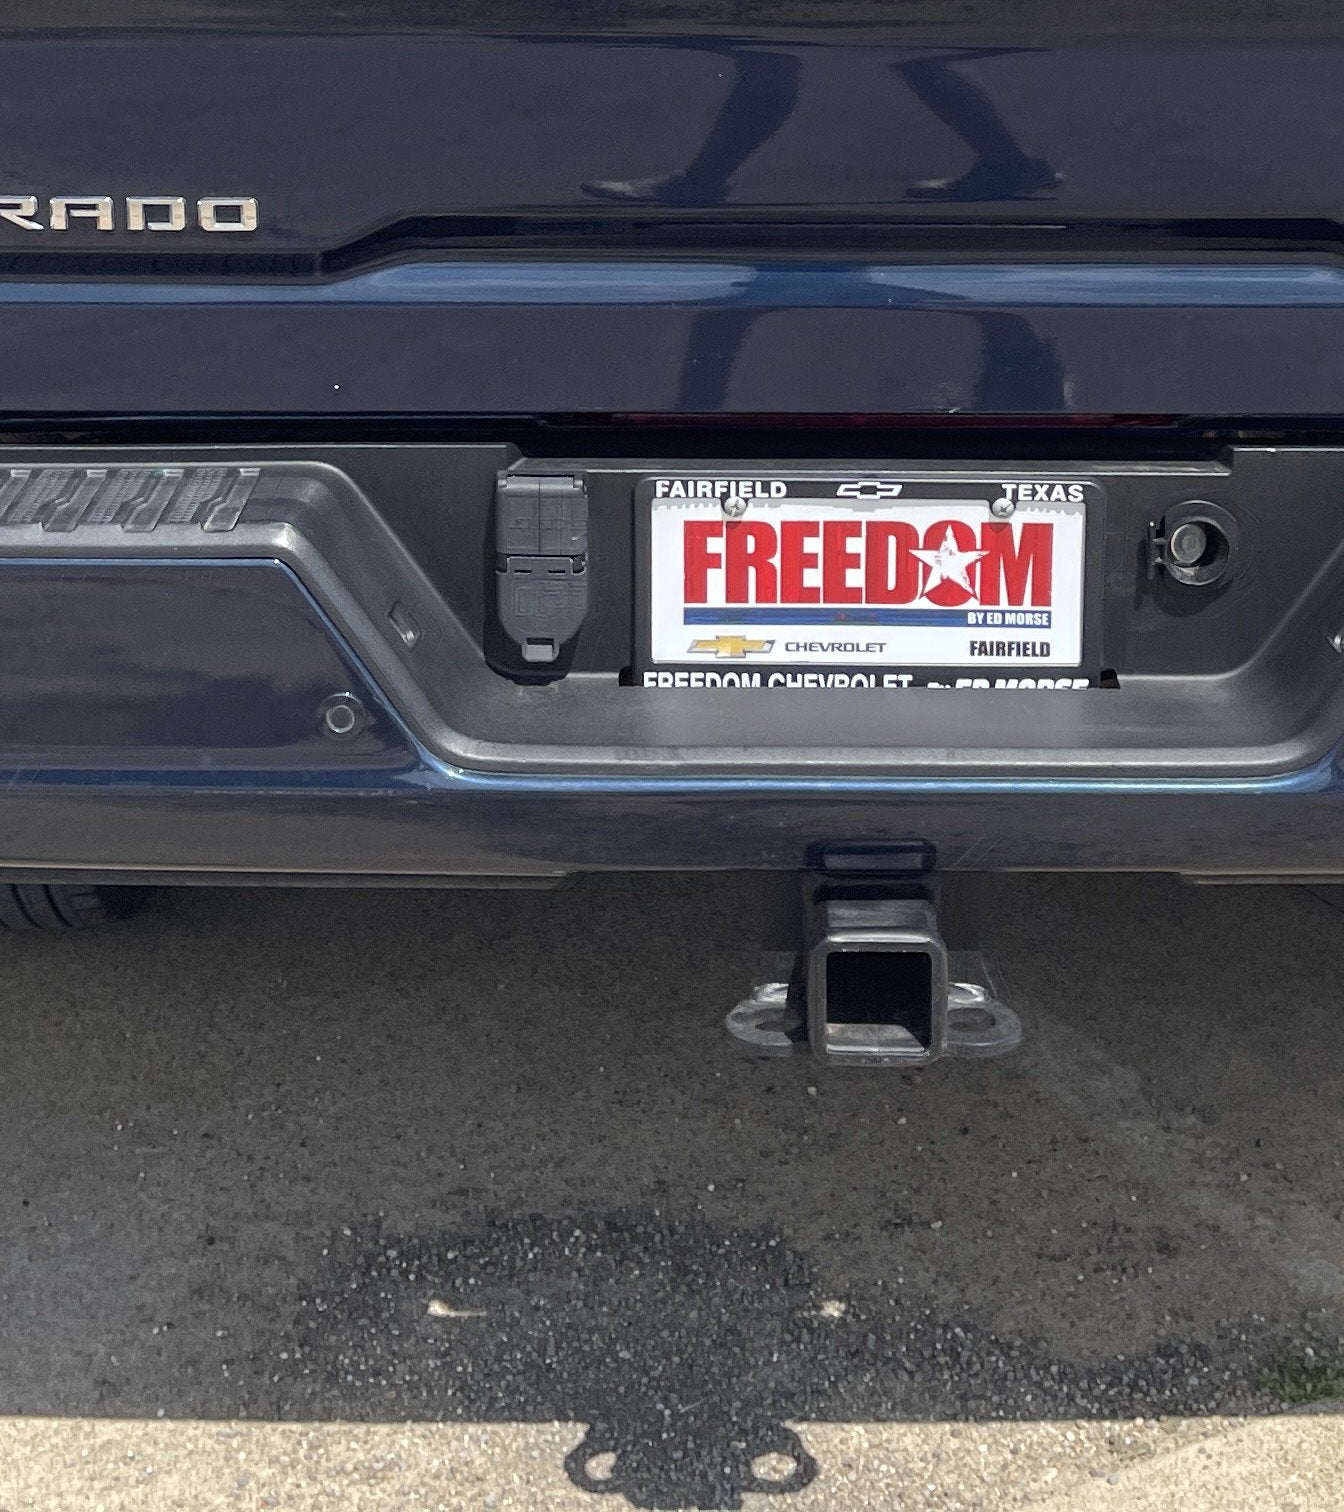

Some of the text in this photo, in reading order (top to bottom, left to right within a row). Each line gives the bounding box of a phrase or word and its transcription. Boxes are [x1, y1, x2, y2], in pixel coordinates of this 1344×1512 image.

[655, 480, 1085, 503] FAIRFIELD TEXAS
[683, 519, 1053, 608] FREEDOM
[967, 612, 1049, 626] BY ED MORSE
[784, 641, 887, 655] CHEVROLET
[969, 640, 1051, 658] FAIRFIELD
